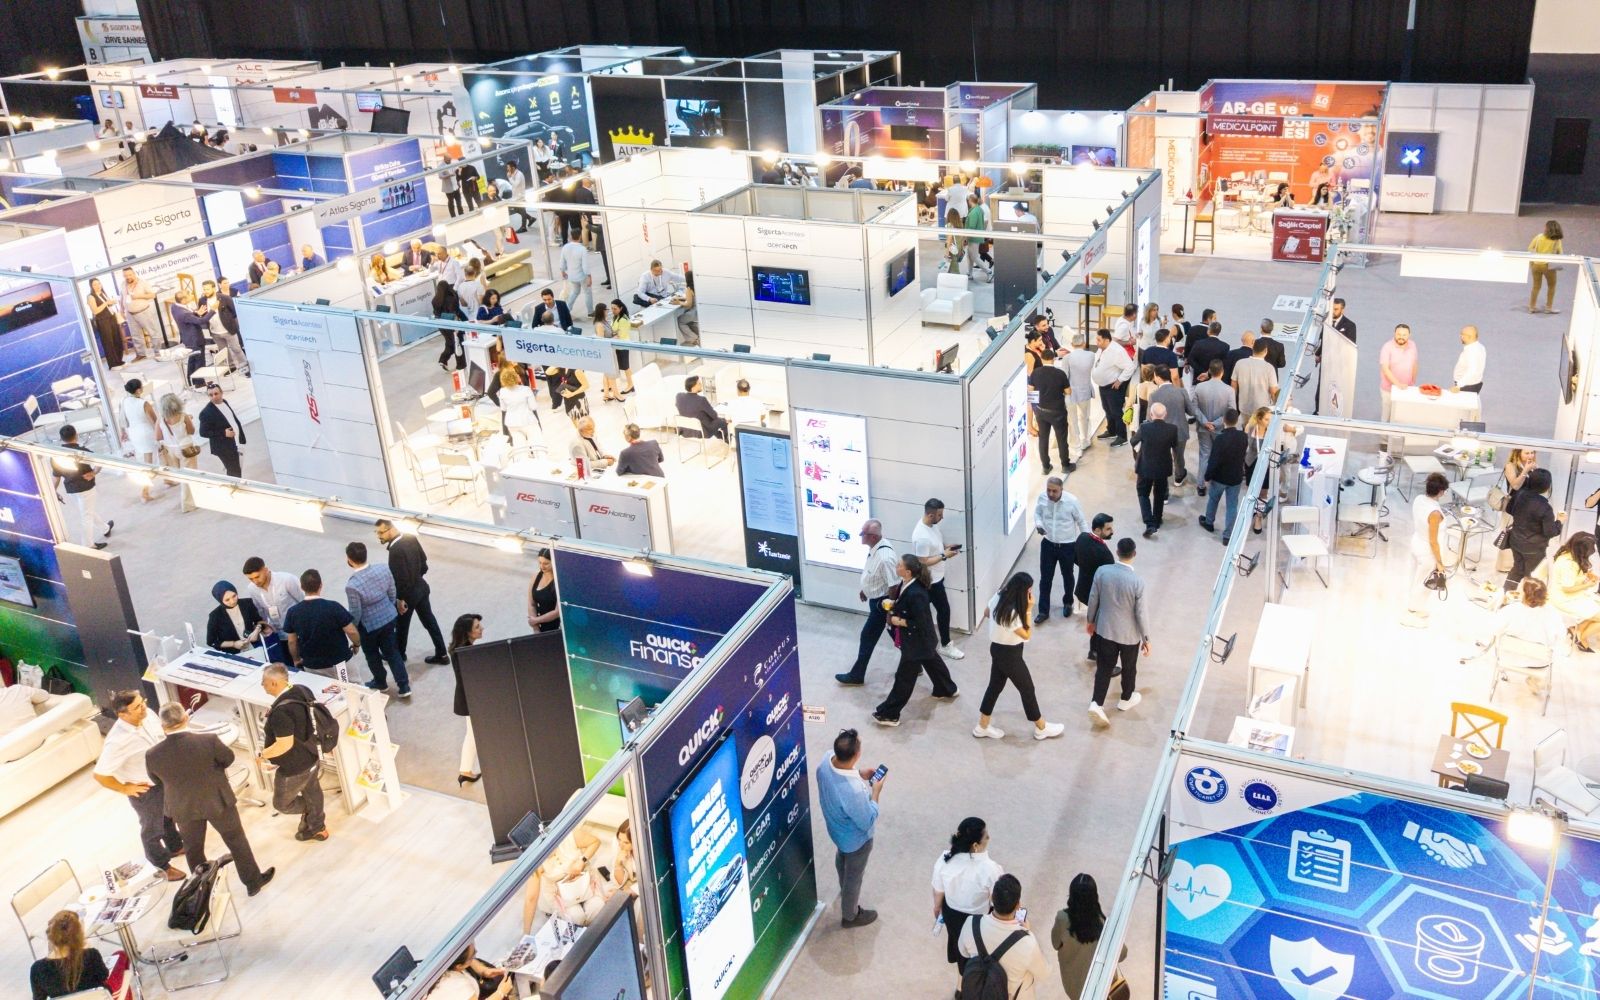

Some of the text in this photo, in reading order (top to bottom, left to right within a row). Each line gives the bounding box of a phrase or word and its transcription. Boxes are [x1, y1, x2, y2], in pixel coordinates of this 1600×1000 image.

[122, 36, 147, 44] SAHNES
[89, 48, 98, 60] B
[146, 86, 173, 94] A.L.C
[1221, 101, 1299, 115] AR-GE ve
[1212, 122, 1277, 132] MEDICALPOINT
[329, 196, 376, 216] Atlas Sigorta
[126, 209, 192, 234] Atlas Sigorta
[516, 492, 560, 509] RS Holding
[588, 504, 636, 521] RS Holding
[646, 634, 692, 654] QUICK
[764, 635, 790, 669] CORPUS
[630, 640, 704, 669] Finansa
[766, 694, 788, 726] QUICK
[678, 708, 720, 766] QUICK
[776, 745, 799, 780] QUICK
[714, 956, 732, 990] QUICK
